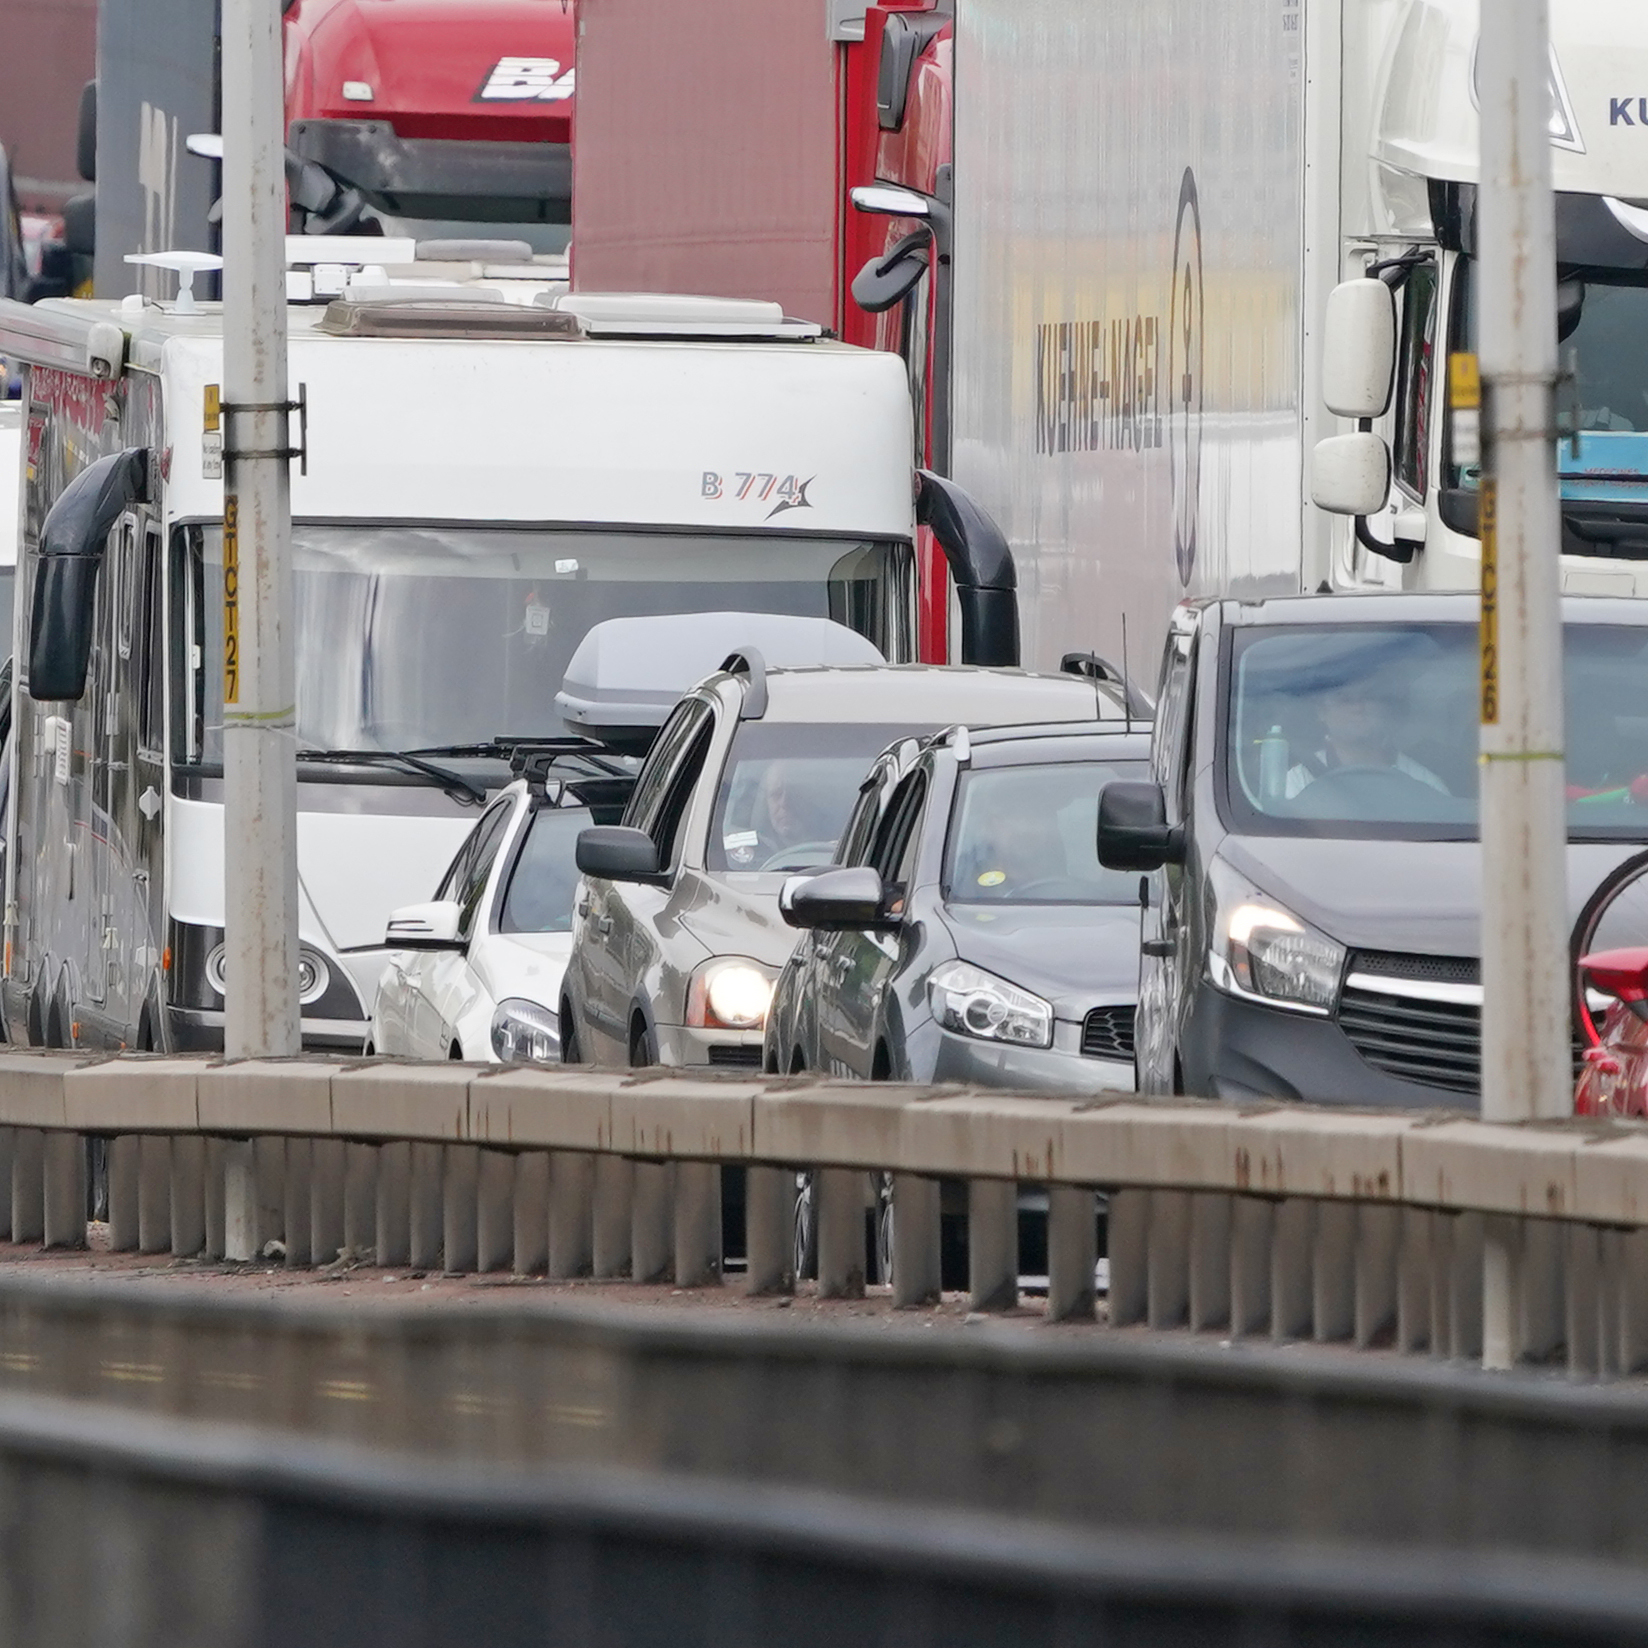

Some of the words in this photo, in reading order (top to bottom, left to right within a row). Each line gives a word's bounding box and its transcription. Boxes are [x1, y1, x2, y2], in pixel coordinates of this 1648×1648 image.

[1036, 314, 1163, 458] KUEHNE+NAGEL
[701, 471, 723, 500] B
[734, 472, 801, 503] 774
[224, 498, 239, 700] GTCT27
